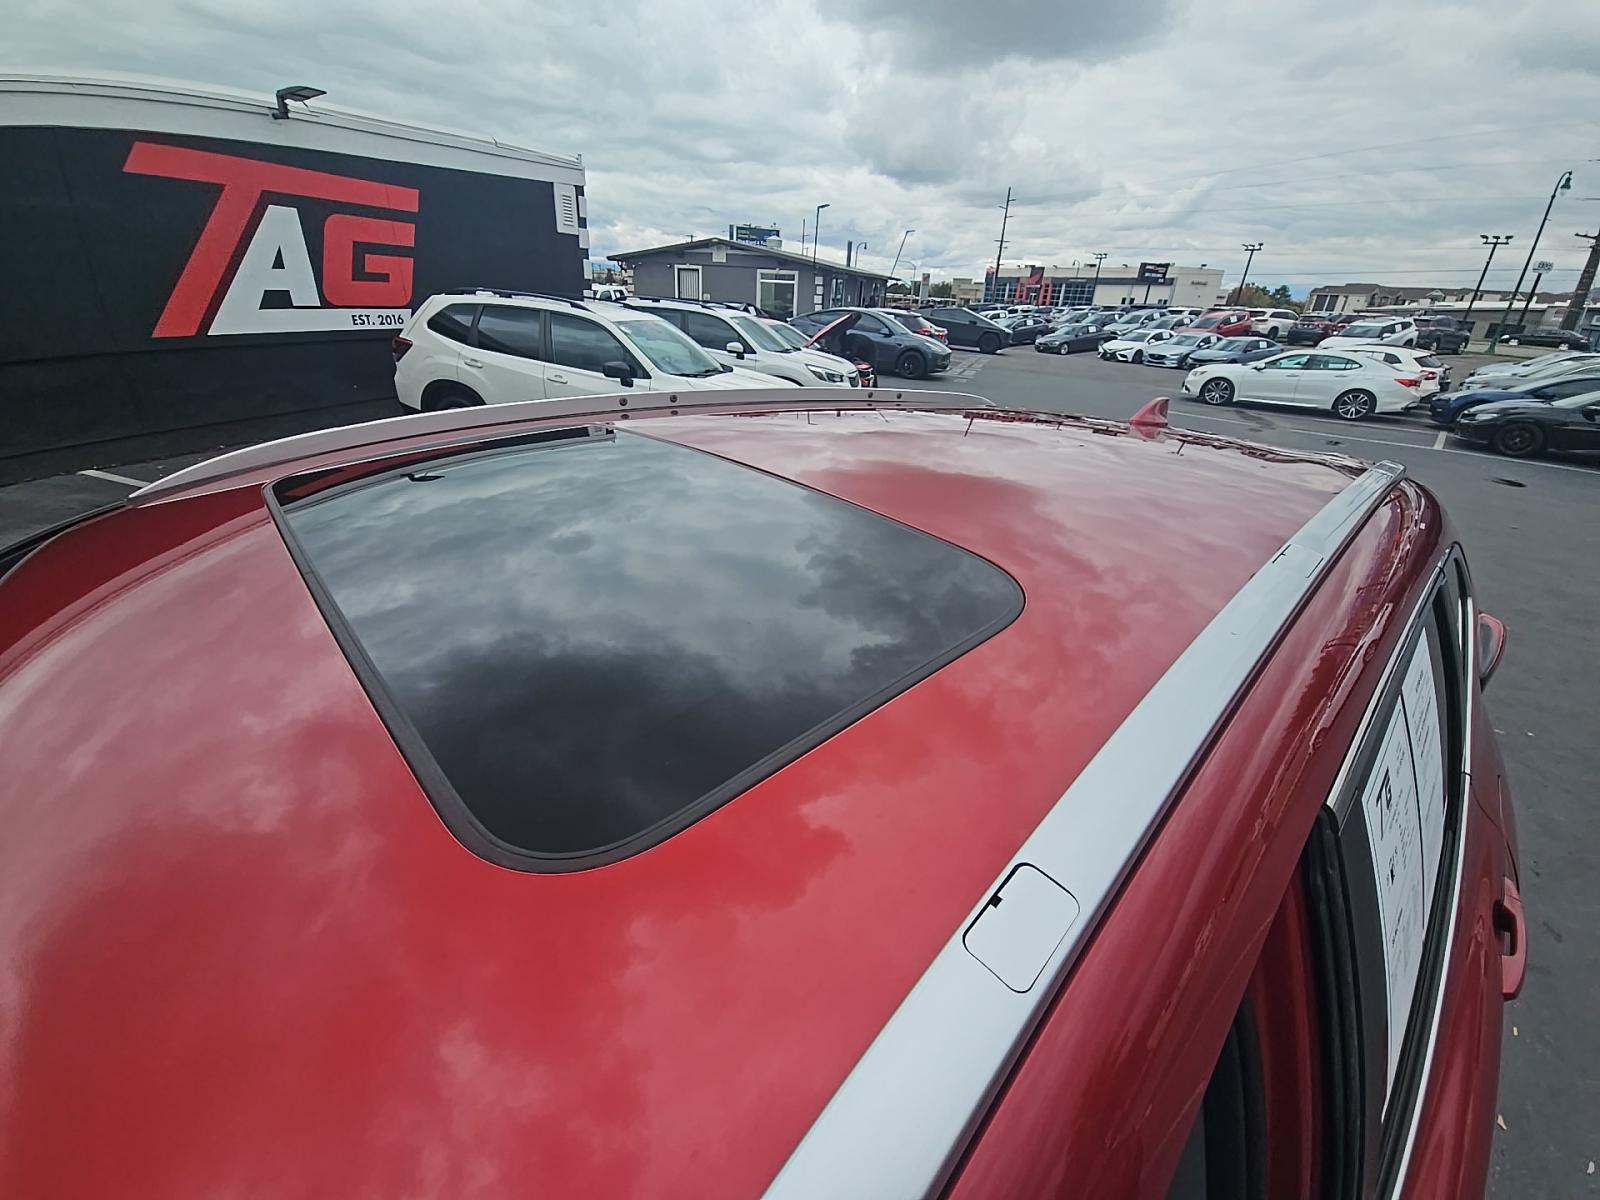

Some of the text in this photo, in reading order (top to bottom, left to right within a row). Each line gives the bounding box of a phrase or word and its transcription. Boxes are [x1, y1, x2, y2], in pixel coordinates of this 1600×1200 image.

[123, 142, 419, 338] TAG
[352, 314, 405, 325] EST. 2016
